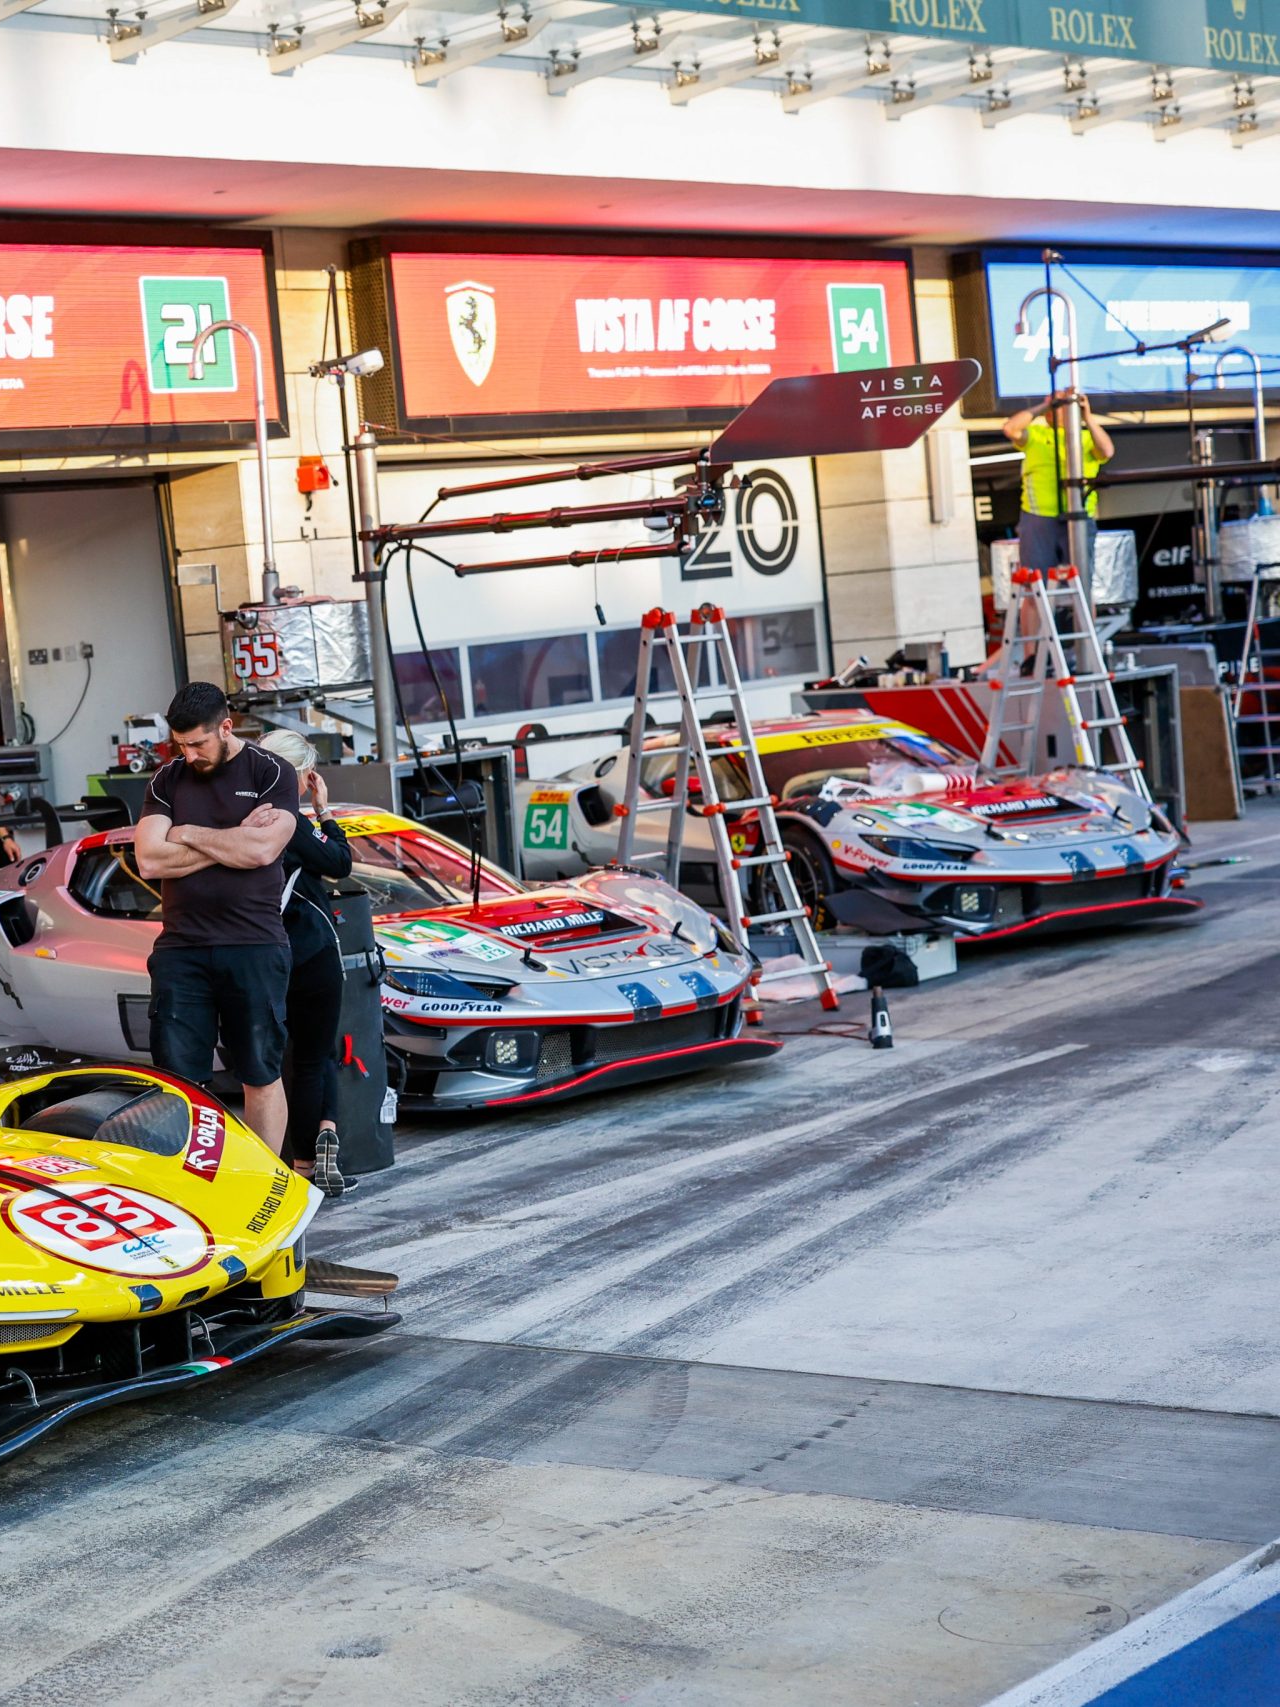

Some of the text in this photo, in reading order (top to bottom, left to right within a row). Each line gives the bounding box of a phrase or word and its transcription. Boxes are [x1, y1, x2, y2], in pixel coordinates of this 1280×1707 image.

[890, 0, 987, 34] ROLEX
[1049, 6, 1137, 49] ROLEX
[1203, 26, 1280, 66] ROLEX
[160, 303, 217, 365] 21
[575, 297, 777, 353] VISTA AF CORSE
[839, 306, 880, 354] 54
[859, 374, 943, 394] VISTA
[861, 402, 944, 419] AF CORSE
[1153, 544, 1192, 567] elf
[232, 632, 279, 680] 55
[971, 796, 1059, 816] RICHARD MILLE
[529, 808, 563, 845] 54
[843, 843, 891, 868] V-Power
[500, 911, 605, 937] RICHARD MILLE
[420, 1001, 503, 1014] GOODYEAR
[196, 1105, 218, 1148] ORLEN
[40, 1193, 156, 1241] 83
[246, 1167, 290, 1234] RICHARD MILLE
[122, 1233, 165, 1254] WEC
